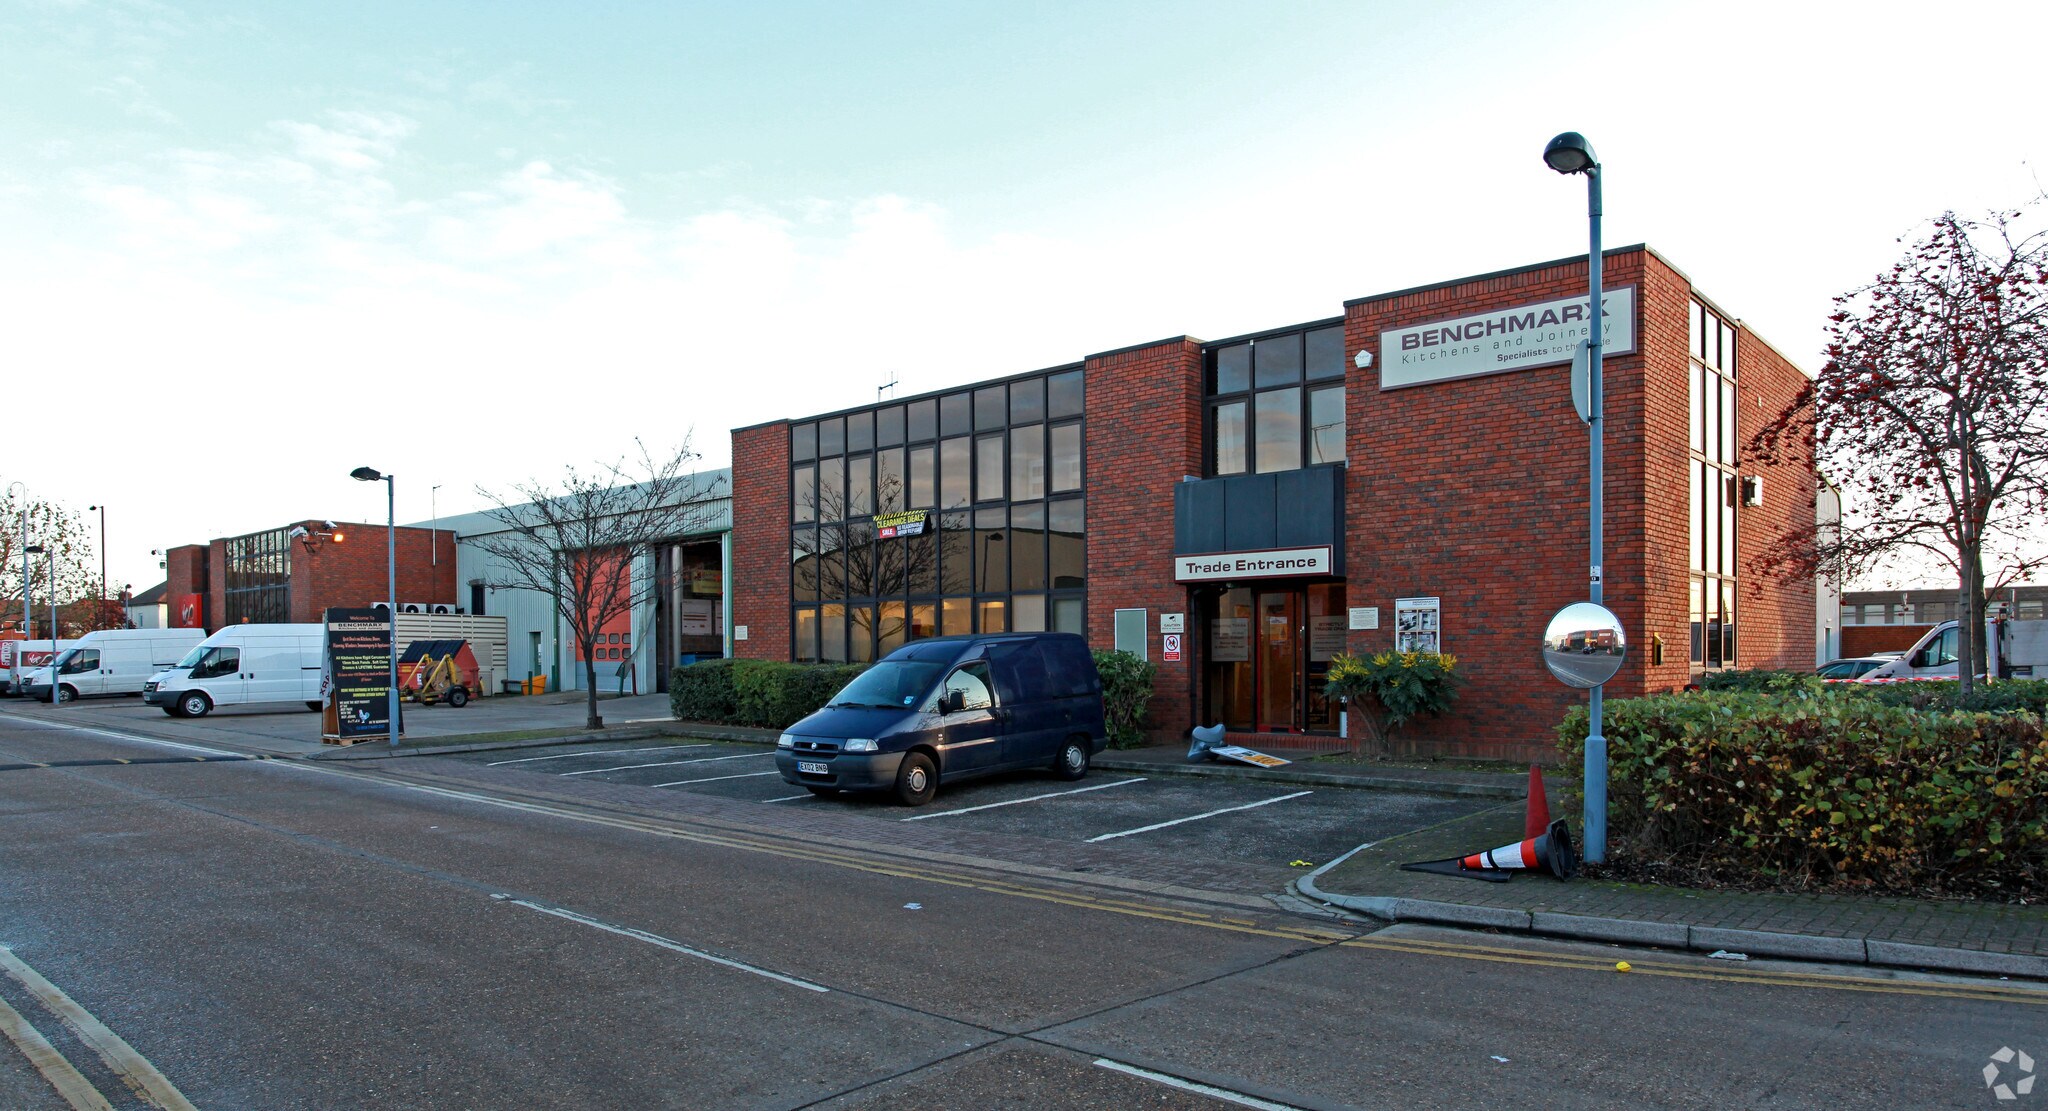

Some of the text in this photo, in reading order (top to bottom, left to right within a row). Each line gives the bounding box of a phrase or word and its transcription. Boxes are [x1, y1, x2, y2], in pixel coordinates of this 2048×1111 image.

[1401, 298, 1610, 351] BENCHMARX
[1402, 323, 1611, 364] Kitchens and Joiney
[1497, 346, 1548, 362] Specialists
[1552, 345, 1563, 354] to
[877, 513, 924, 529] CLEARANCE DEALS
[1186, 558, 1317, 574] Trade Entrance
[800, 762, 815, 771] EX02
